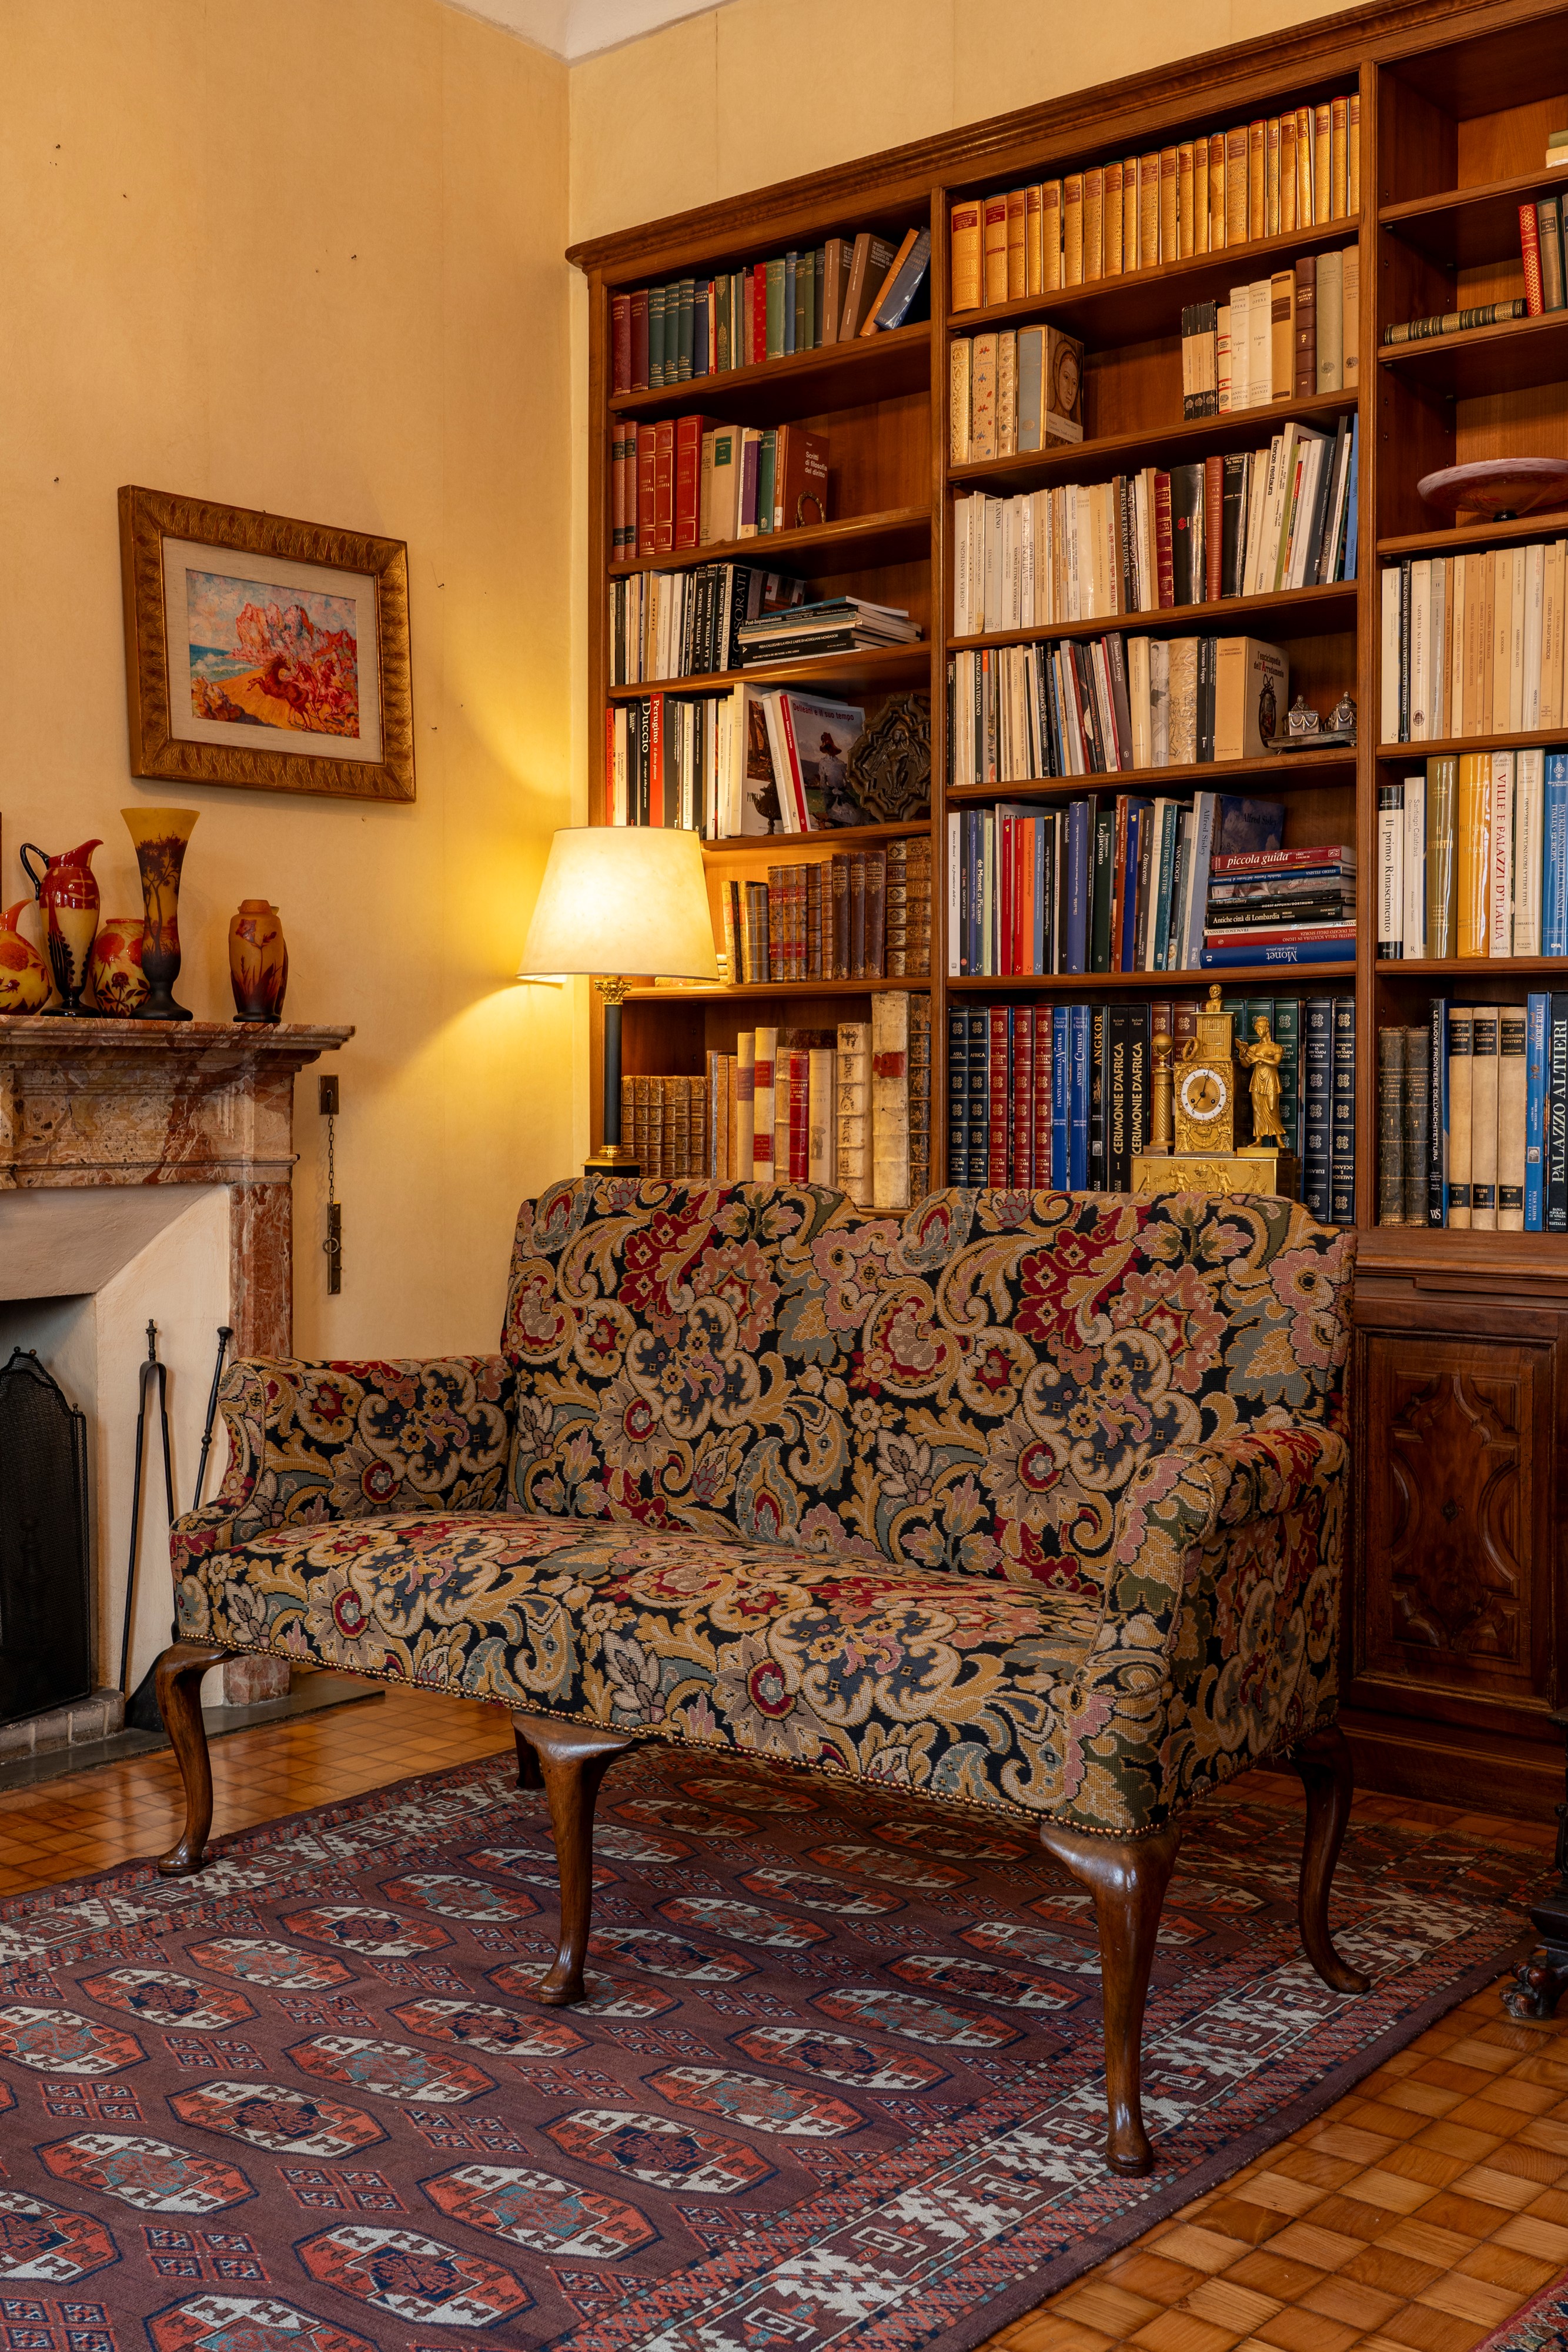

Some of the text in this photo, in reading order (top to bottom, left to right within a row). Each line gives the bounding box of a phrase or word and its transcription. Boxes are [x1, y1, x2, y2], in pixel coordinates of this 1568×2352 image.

[805, 451, 819, 460] Scritti
[810, 460, 827, 471] filosofia
[1268, 439, 1280, 496] firenze restaura
[813, 469, 825, 478] diritto
[745, 617, 782, 626] Post-Impressionism
[696, 646, 700, 654] LA
[705, 649, 710, 657] LA
[717, 644, 721, 653] LA
[651, 700, 660, 744] Perugino
[793, 703, 813, 714] Delleani
[836, 713, 854, 721] tempo
[642, 701, 651, 753] Duccio
[1497, 773, 1506, 810] VILLE
[1097, 823, 1107, 865] Lojacono
[1199, 808, 1211, 857] Alfred Sisley
[1382, 831, 1395, 861] primo
[978, 859, 983, 868] da
[1226, 852, 1289, 868] piccola guida
[1496, 827, 1506, 879] PALAZZI
[1385, 866, 1395, 933] Rinascimento
[1495, 885, 1505, 941] D'ITALIA
[1252, 913, 1280, 921] Lombardia
[1266, 951, 1298, 962] Monet
[1433, 1010, 1439, 1019] LE
[1094, 1015, 1103, 1066] ANGKOR
[1536, 1025, 1544, 1050] DIMORE
[1114, 1042, 1124, 1154] CERIMONIE D'AFRICA
[1132, 1042, 1143, 1154] CERIMONIE D'AFRICA
[1552, 1019, 1567, 1184] PALAZZO ALTIERI
